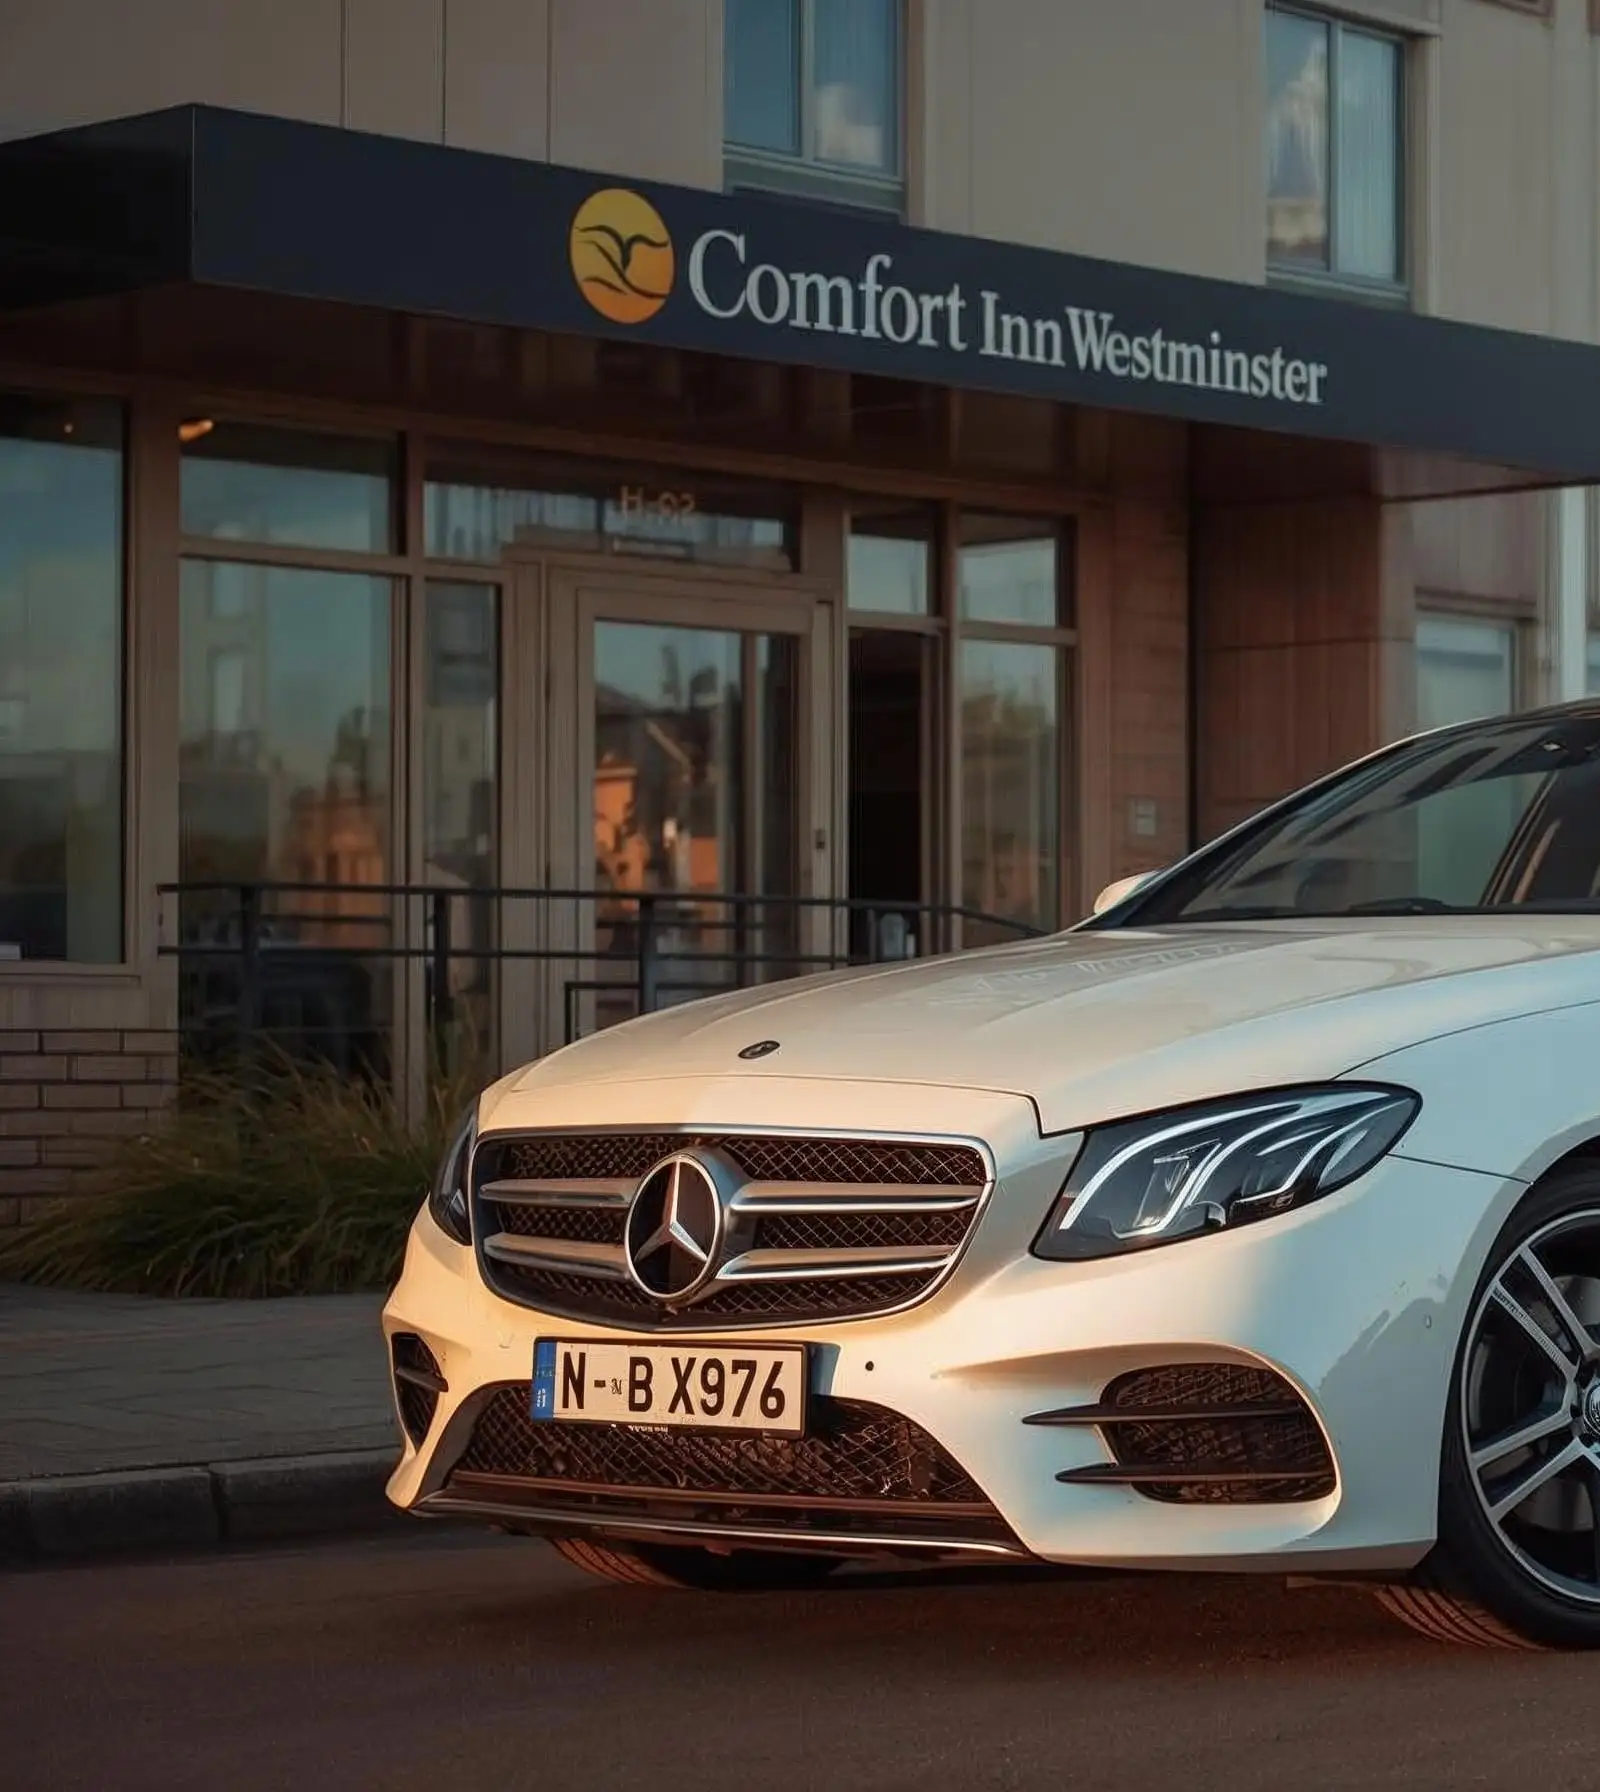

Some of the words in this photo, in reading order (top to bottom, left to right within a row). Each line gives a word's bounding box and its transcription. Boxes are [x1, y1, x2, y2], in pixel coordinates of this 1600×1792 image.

[688, 229, 967, 352] Comfort
[979, 290, 1065, 367] Inn
[1066, 305, 1328, 404] Westminster
